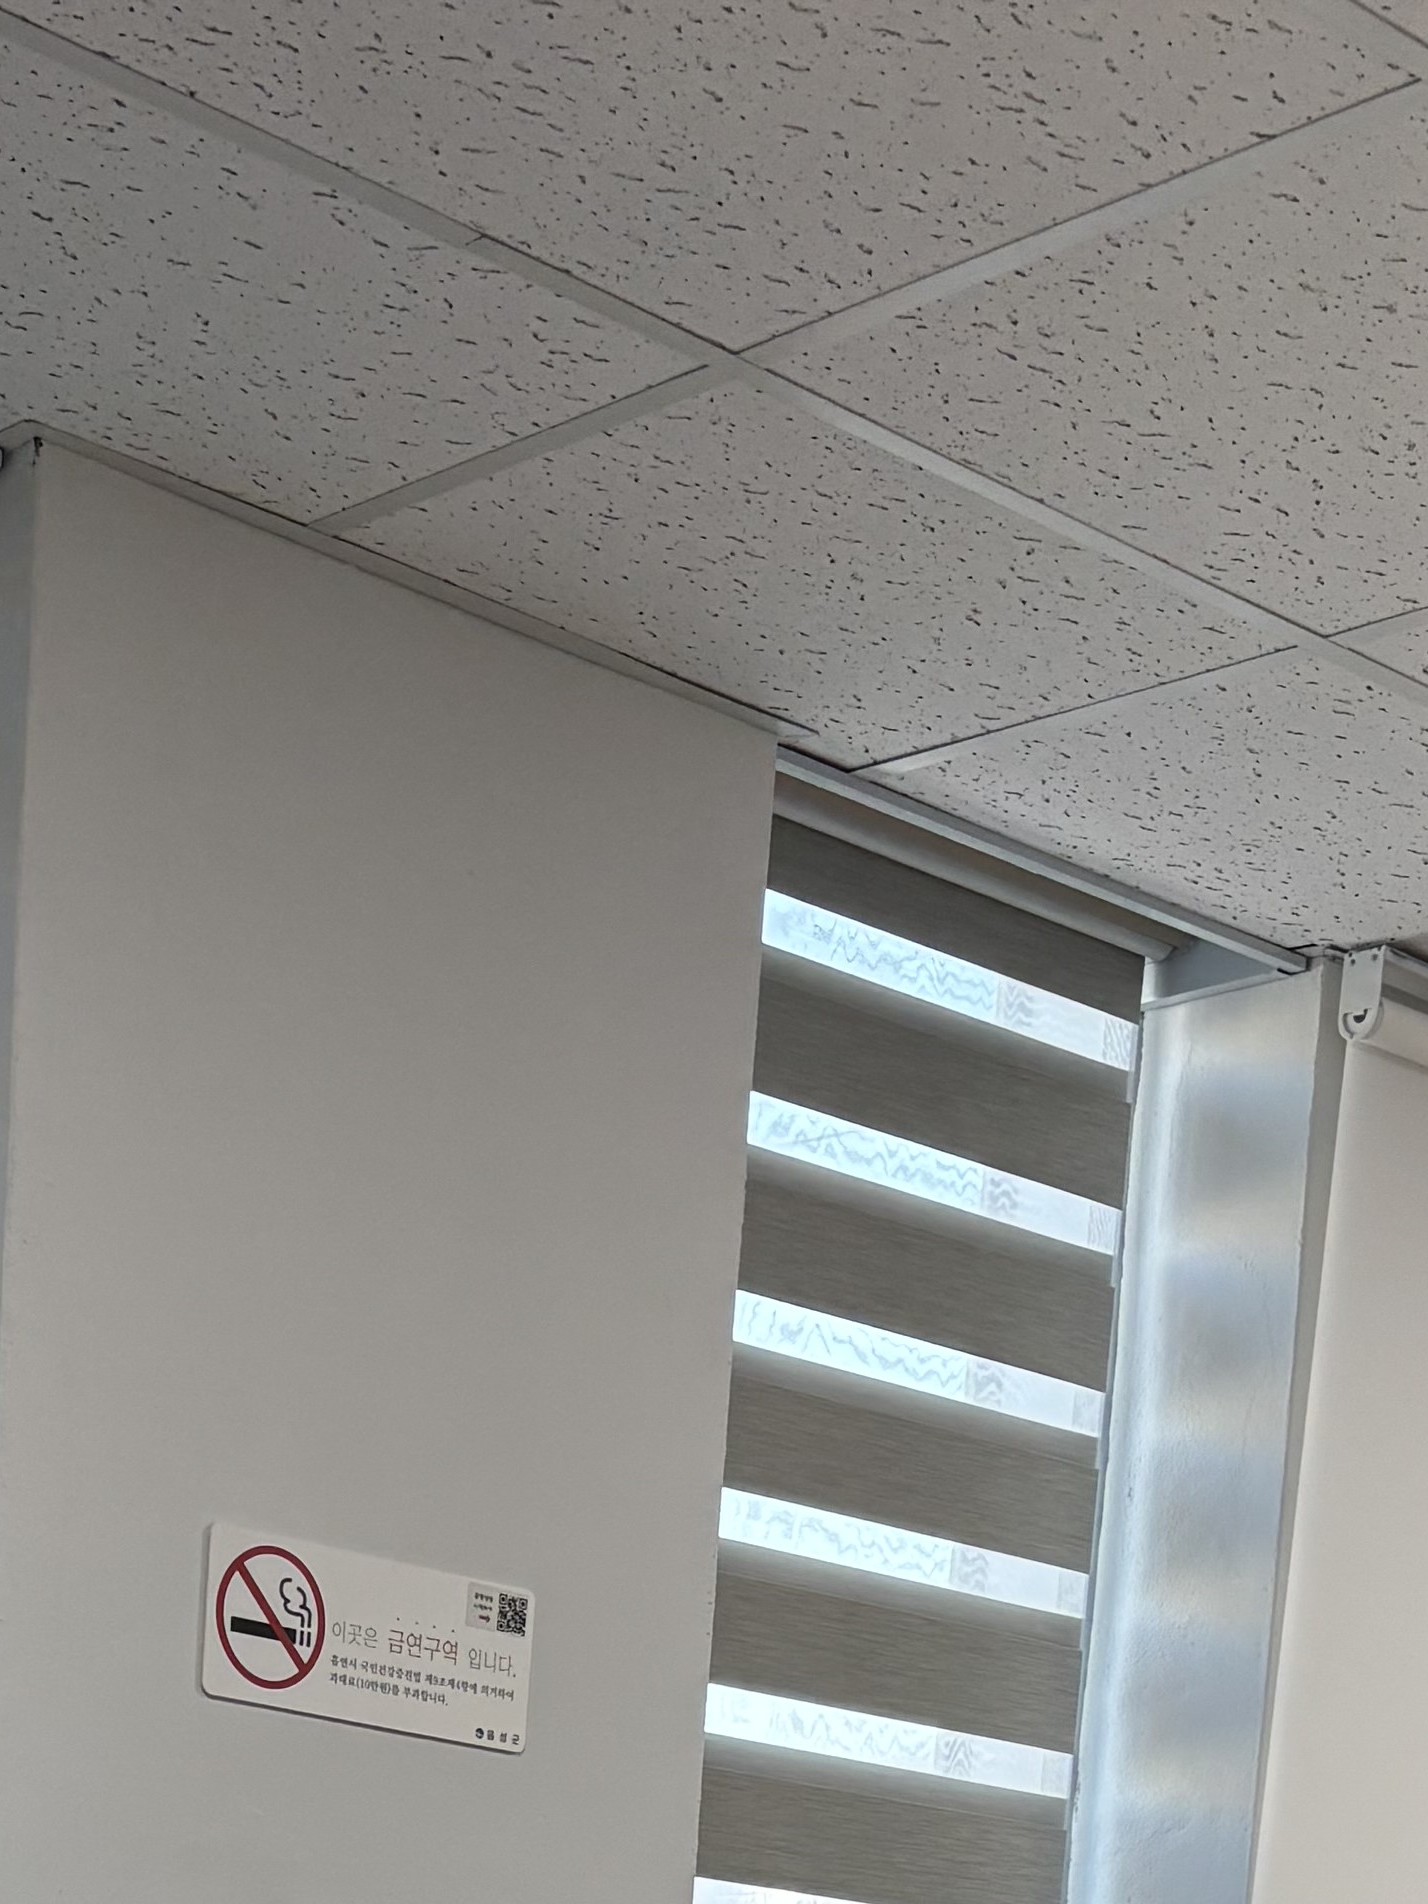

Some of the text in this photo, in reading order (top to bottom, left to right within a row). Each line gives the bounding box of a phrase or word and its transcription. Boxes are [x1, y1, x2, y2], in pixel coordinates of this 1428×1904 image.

[332, 1621, 516, 1678] 이곳은 금연구역 입니다.
